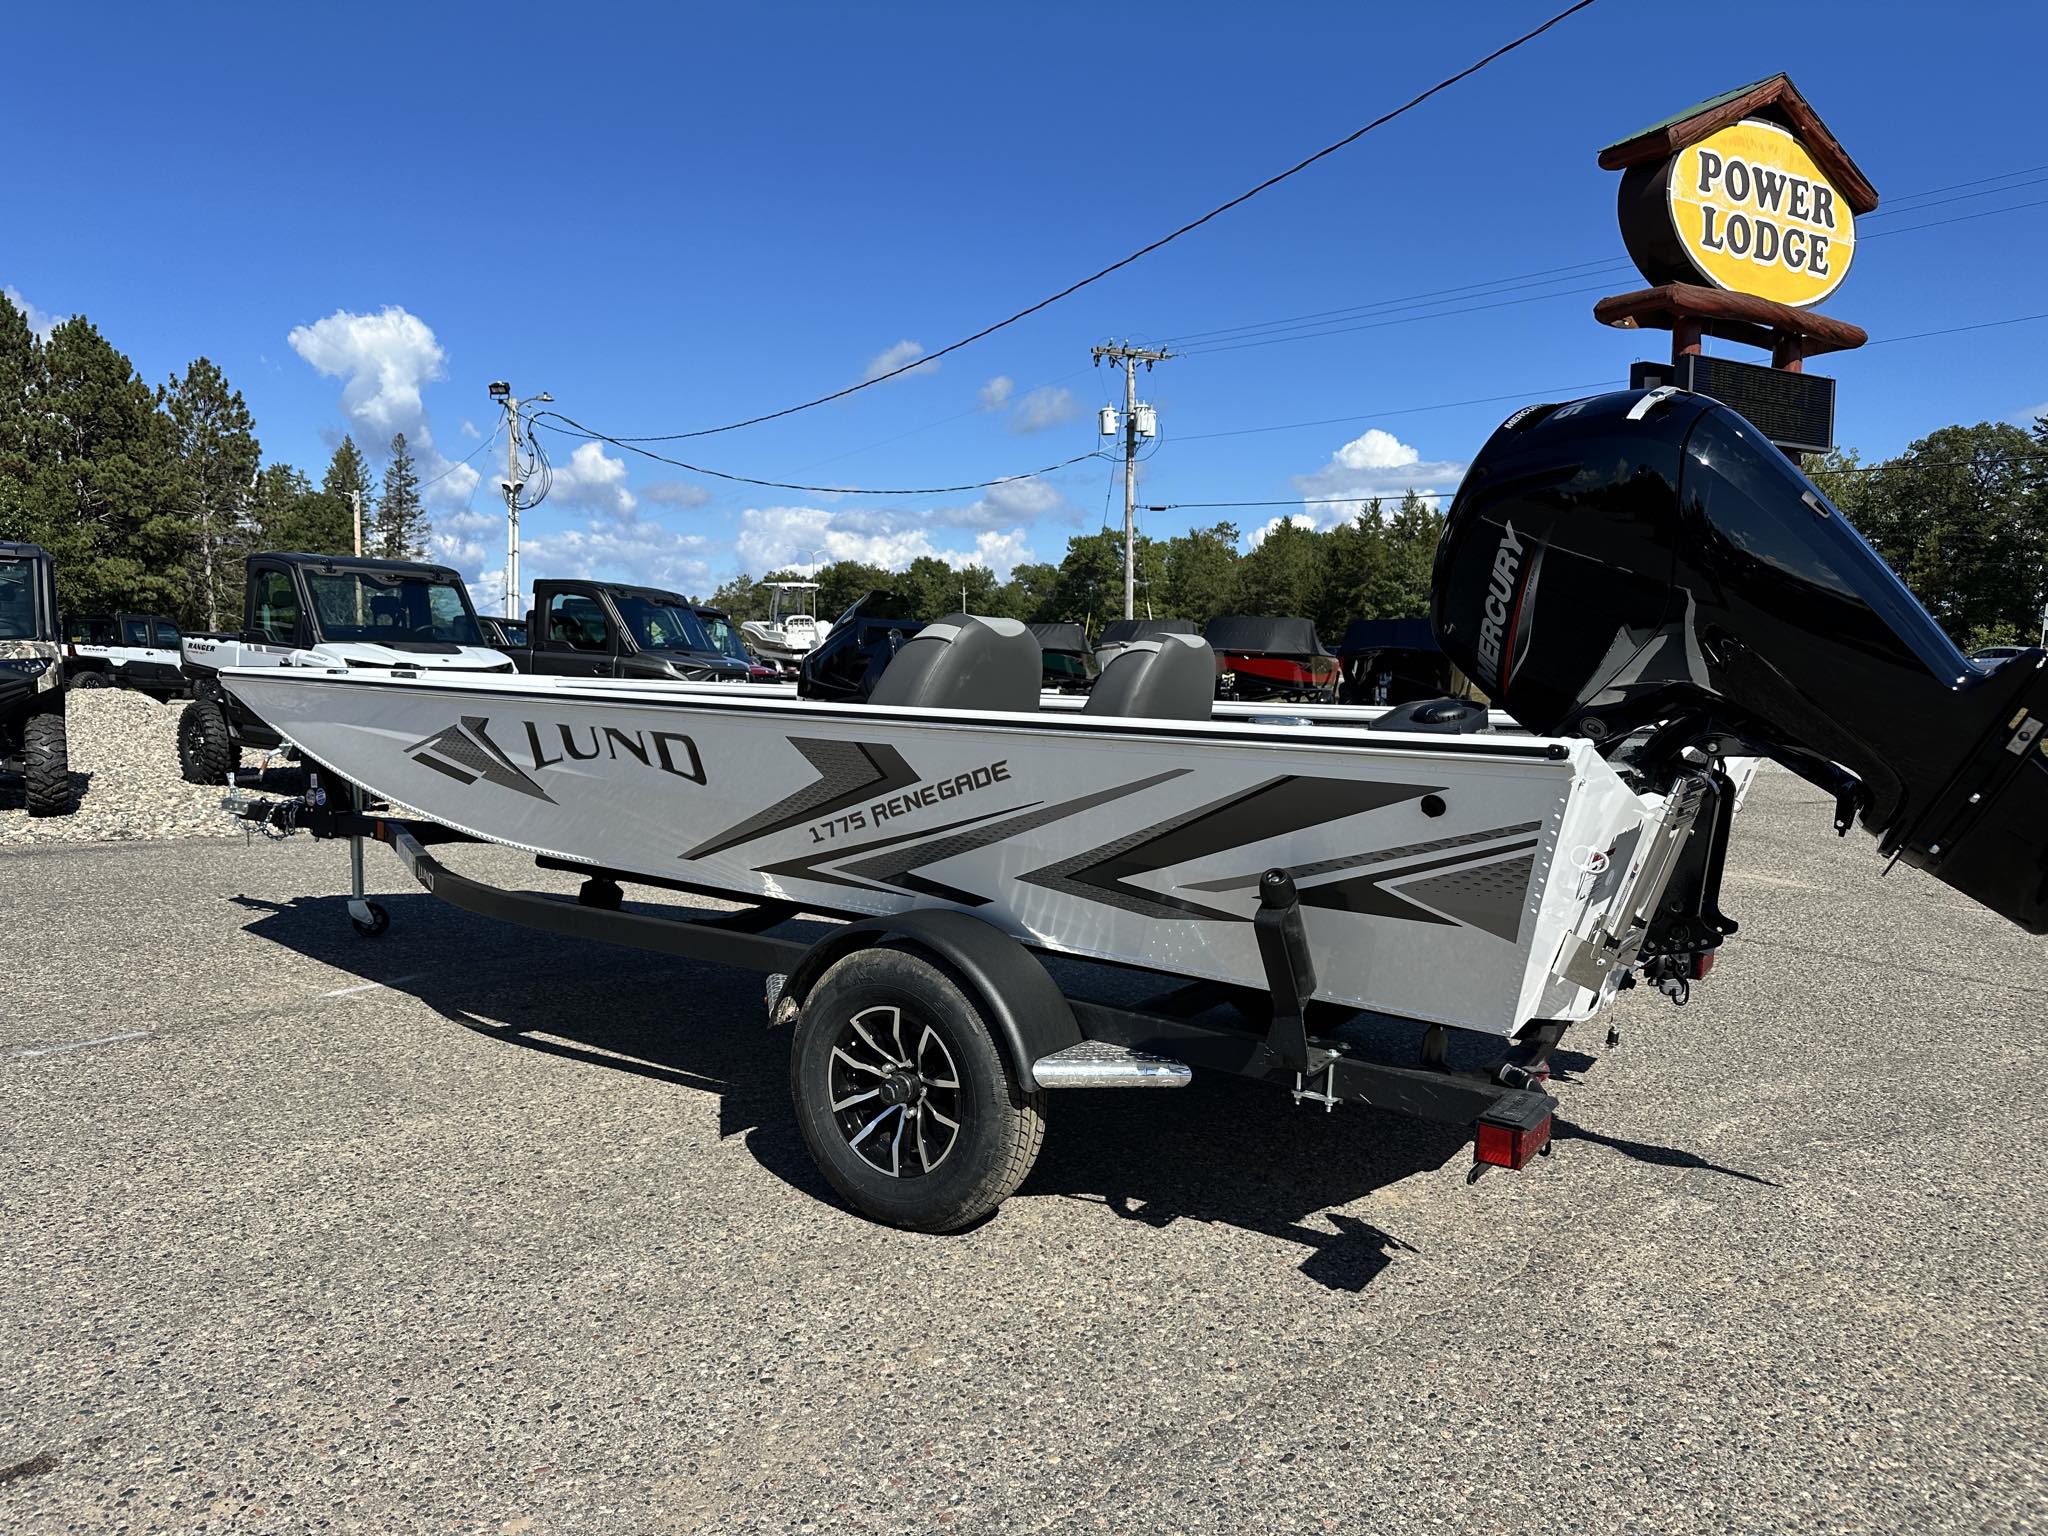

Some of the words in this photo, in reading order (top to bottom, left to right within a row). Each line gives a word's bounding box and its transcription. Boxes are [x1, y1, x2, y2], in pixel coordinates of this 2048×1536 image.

[1698, 150, 1835, 228] POWER
[1702, 205, 1829, 276] LODGE
[1476, 519, 1524, 689] MERCURY
[187, 642, 216, 653] RANGER
[521, 720, 707, 786] LUND
[808, 810, 867, 844] 1775
[870, 759, 1012, 829] RENEGADE
